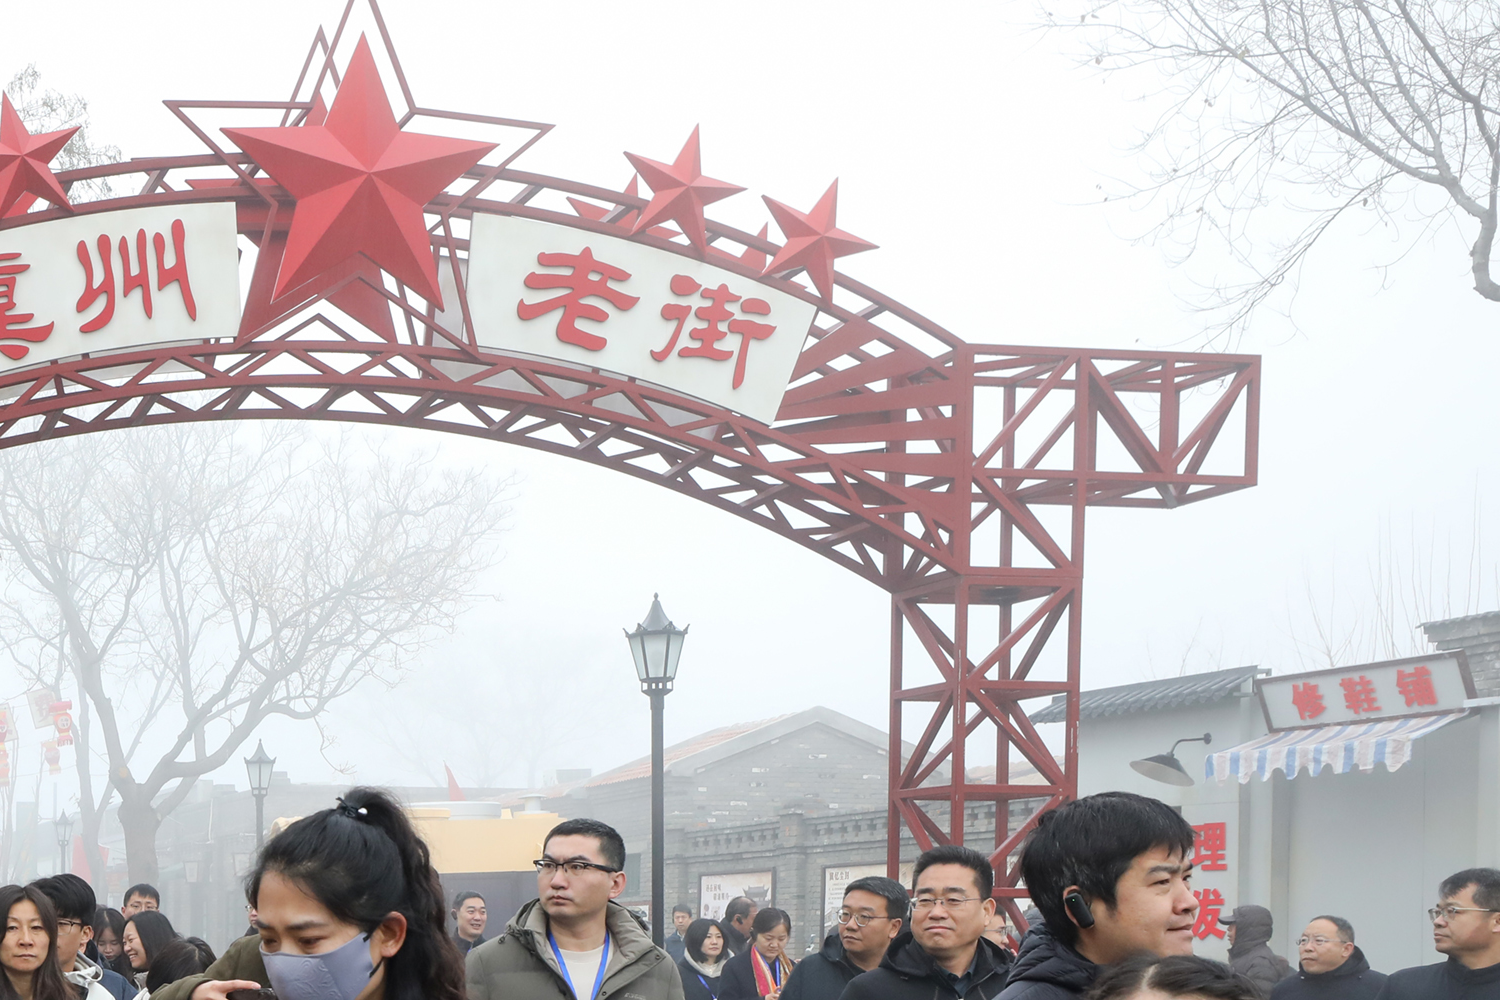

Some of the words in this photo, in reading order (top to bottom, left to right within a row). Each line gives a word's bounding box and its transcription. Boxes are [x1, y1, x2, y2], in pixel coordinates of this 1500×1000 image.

[517, 246, 776, 389] 老街
[1291, 666, 1438, 720] 修鞋铺
[1191, 822, 1227, 940] 理发
